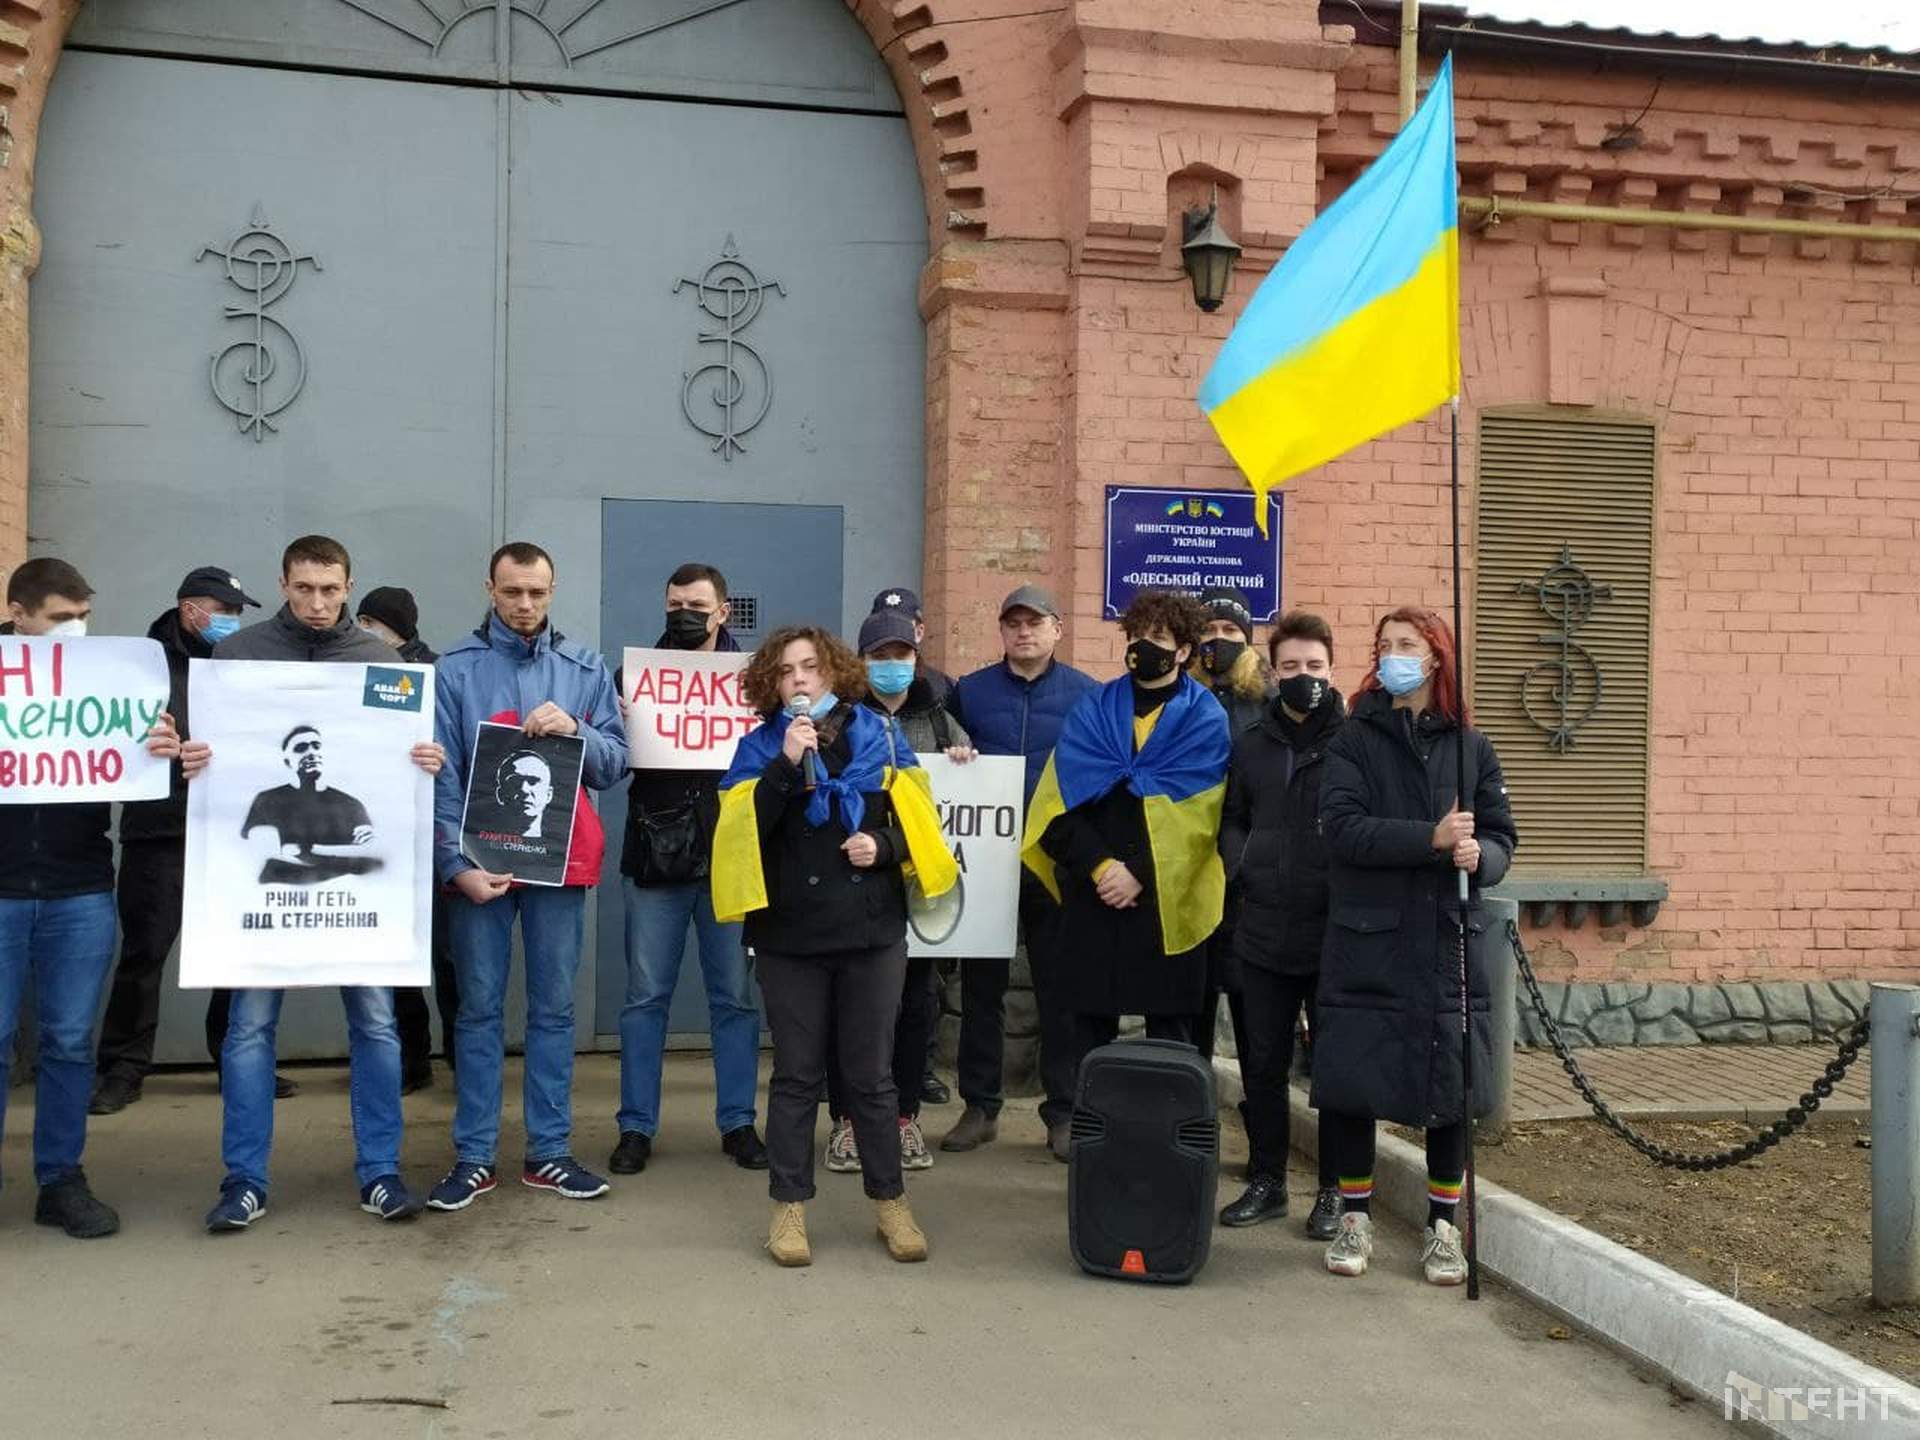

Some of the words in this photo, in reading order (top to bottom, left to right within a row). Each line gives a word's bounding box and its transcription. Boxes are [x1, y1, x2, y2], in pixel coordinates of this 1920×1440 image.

[1135, 523, 1208, 535] МІНІСТЕРСТВО
[1210, 526, 1254, 538] ЮСТИЦІЇ
[1172, 537, 1216, 549] УКРАЇНИ
[1145, 554, 1196, 566] ДЕРЖАВНА
[1197, 556, 1243, 566] УСТАНОВА
[1204, 573, 1265, 588] СЛІДЧИЙ
[656, 711, 758, 750] ЧОРТ
[266, 891, 309, 907] РУКИ
[317, 891, 357, 907] ГЕТЬ
[242, 912, 275, 930] ВІД
